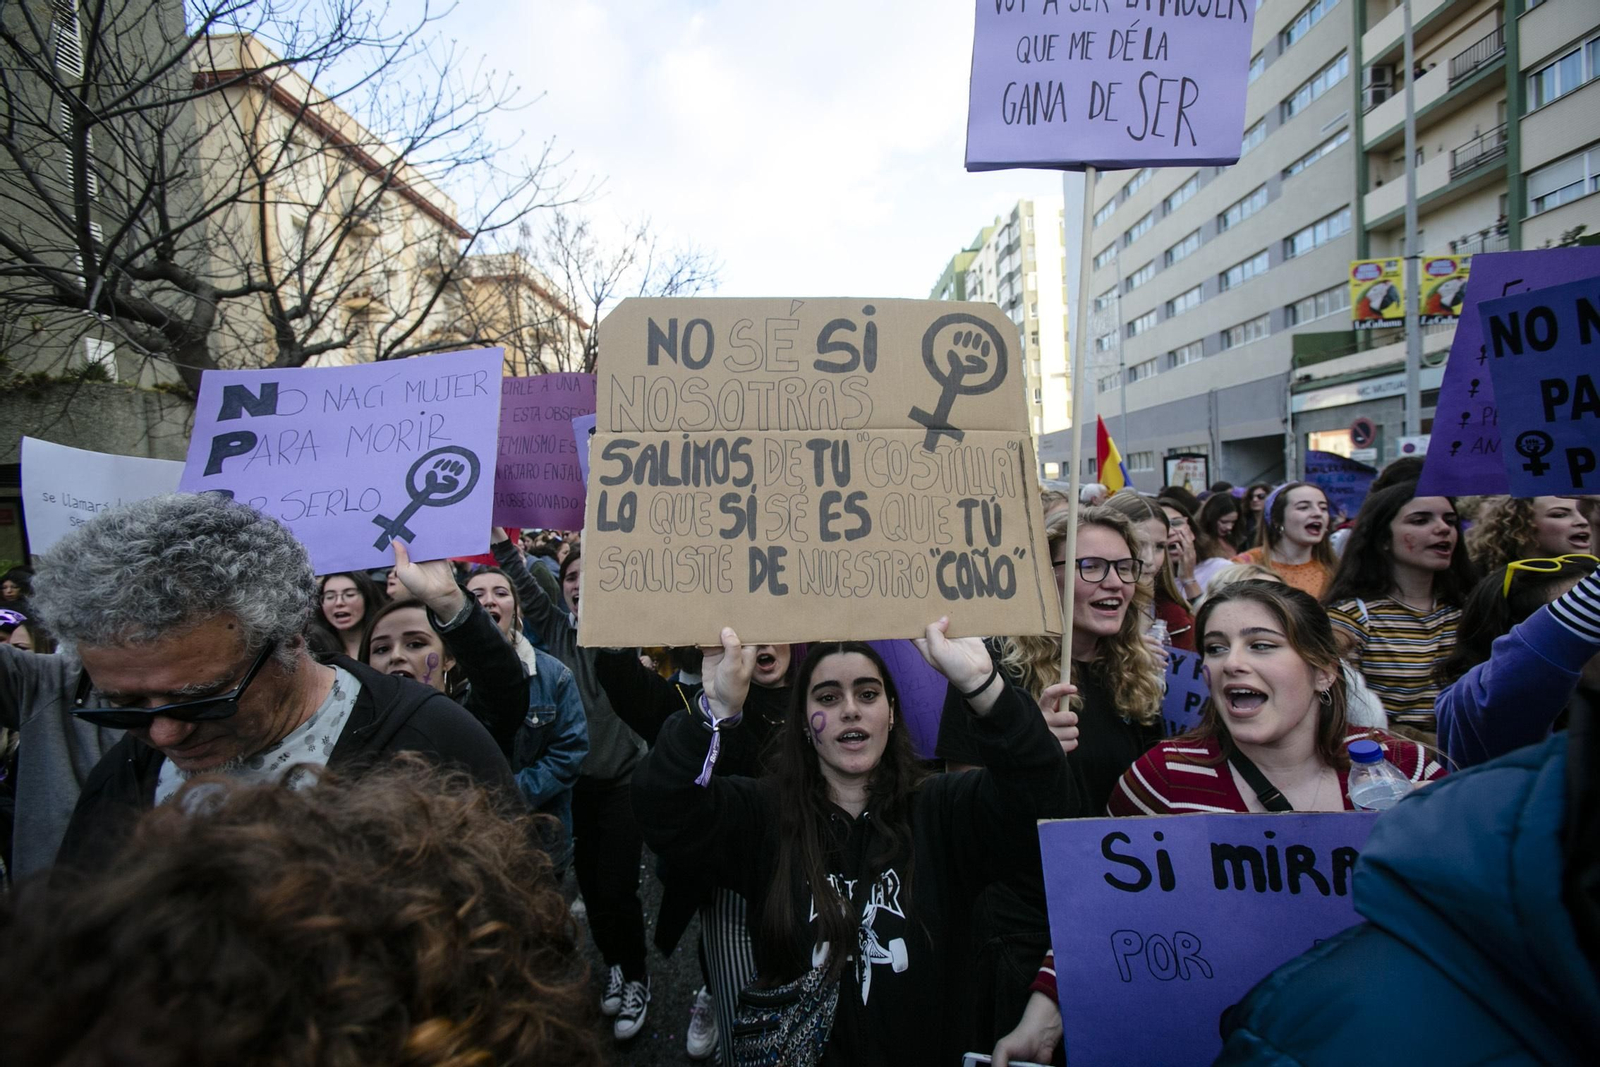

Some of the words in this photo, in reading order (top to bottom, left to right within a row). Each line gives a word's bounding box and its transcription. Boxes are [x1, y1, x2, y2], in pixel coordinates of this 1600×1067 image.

[1016, 33, 1060, 63] QUE
[1068, 31, 1097, 60] ME
[1108, 18, 1141, 61] DÉ
[1143, 27, 1168, 61] LA
[1002, 80, 1067, 125] GANA
[1088, 80, 1122, 121] DE
[1126, 71, 1199, 147] SER
[647, 316, 715, 370] NO
[723, 299, 805, 373] SÉ
[1489, 306, 1558, 358] NO
[216, 382, 308, 423] NO
[405, 370, 488, 404] MUJER
[541, 378, 549, 392] A
[556, 376, 581, 392] UNA
[611, 374, 874, 433] NOSOTRAS
[513, 406, 541, 422] ESTA
[203, 430, 320, 477] PARA
[764, 438, 804, 487] DE
[806, 438, 850, 487] TU
[1565, 446, 1596, 489] P
[42, 492, 56, 504] se
[281, 487, 381, 521] SERLO
[597, 490, 637, 533] LO
[650, 491, 713, 537] QUE
[765, 484, 809, 543] SÉ
[819, 490, 872, 542] ES
[879, 492, 953, 545] QUE
[956, 495, 1002, 547] TÚ
[749, 546, 789, 596] DE
[799, 548, 930, 599] NUESTRO
[930, 547, 1026, 600] "COÑO"
[1110, 929, 1214, 982] POR
